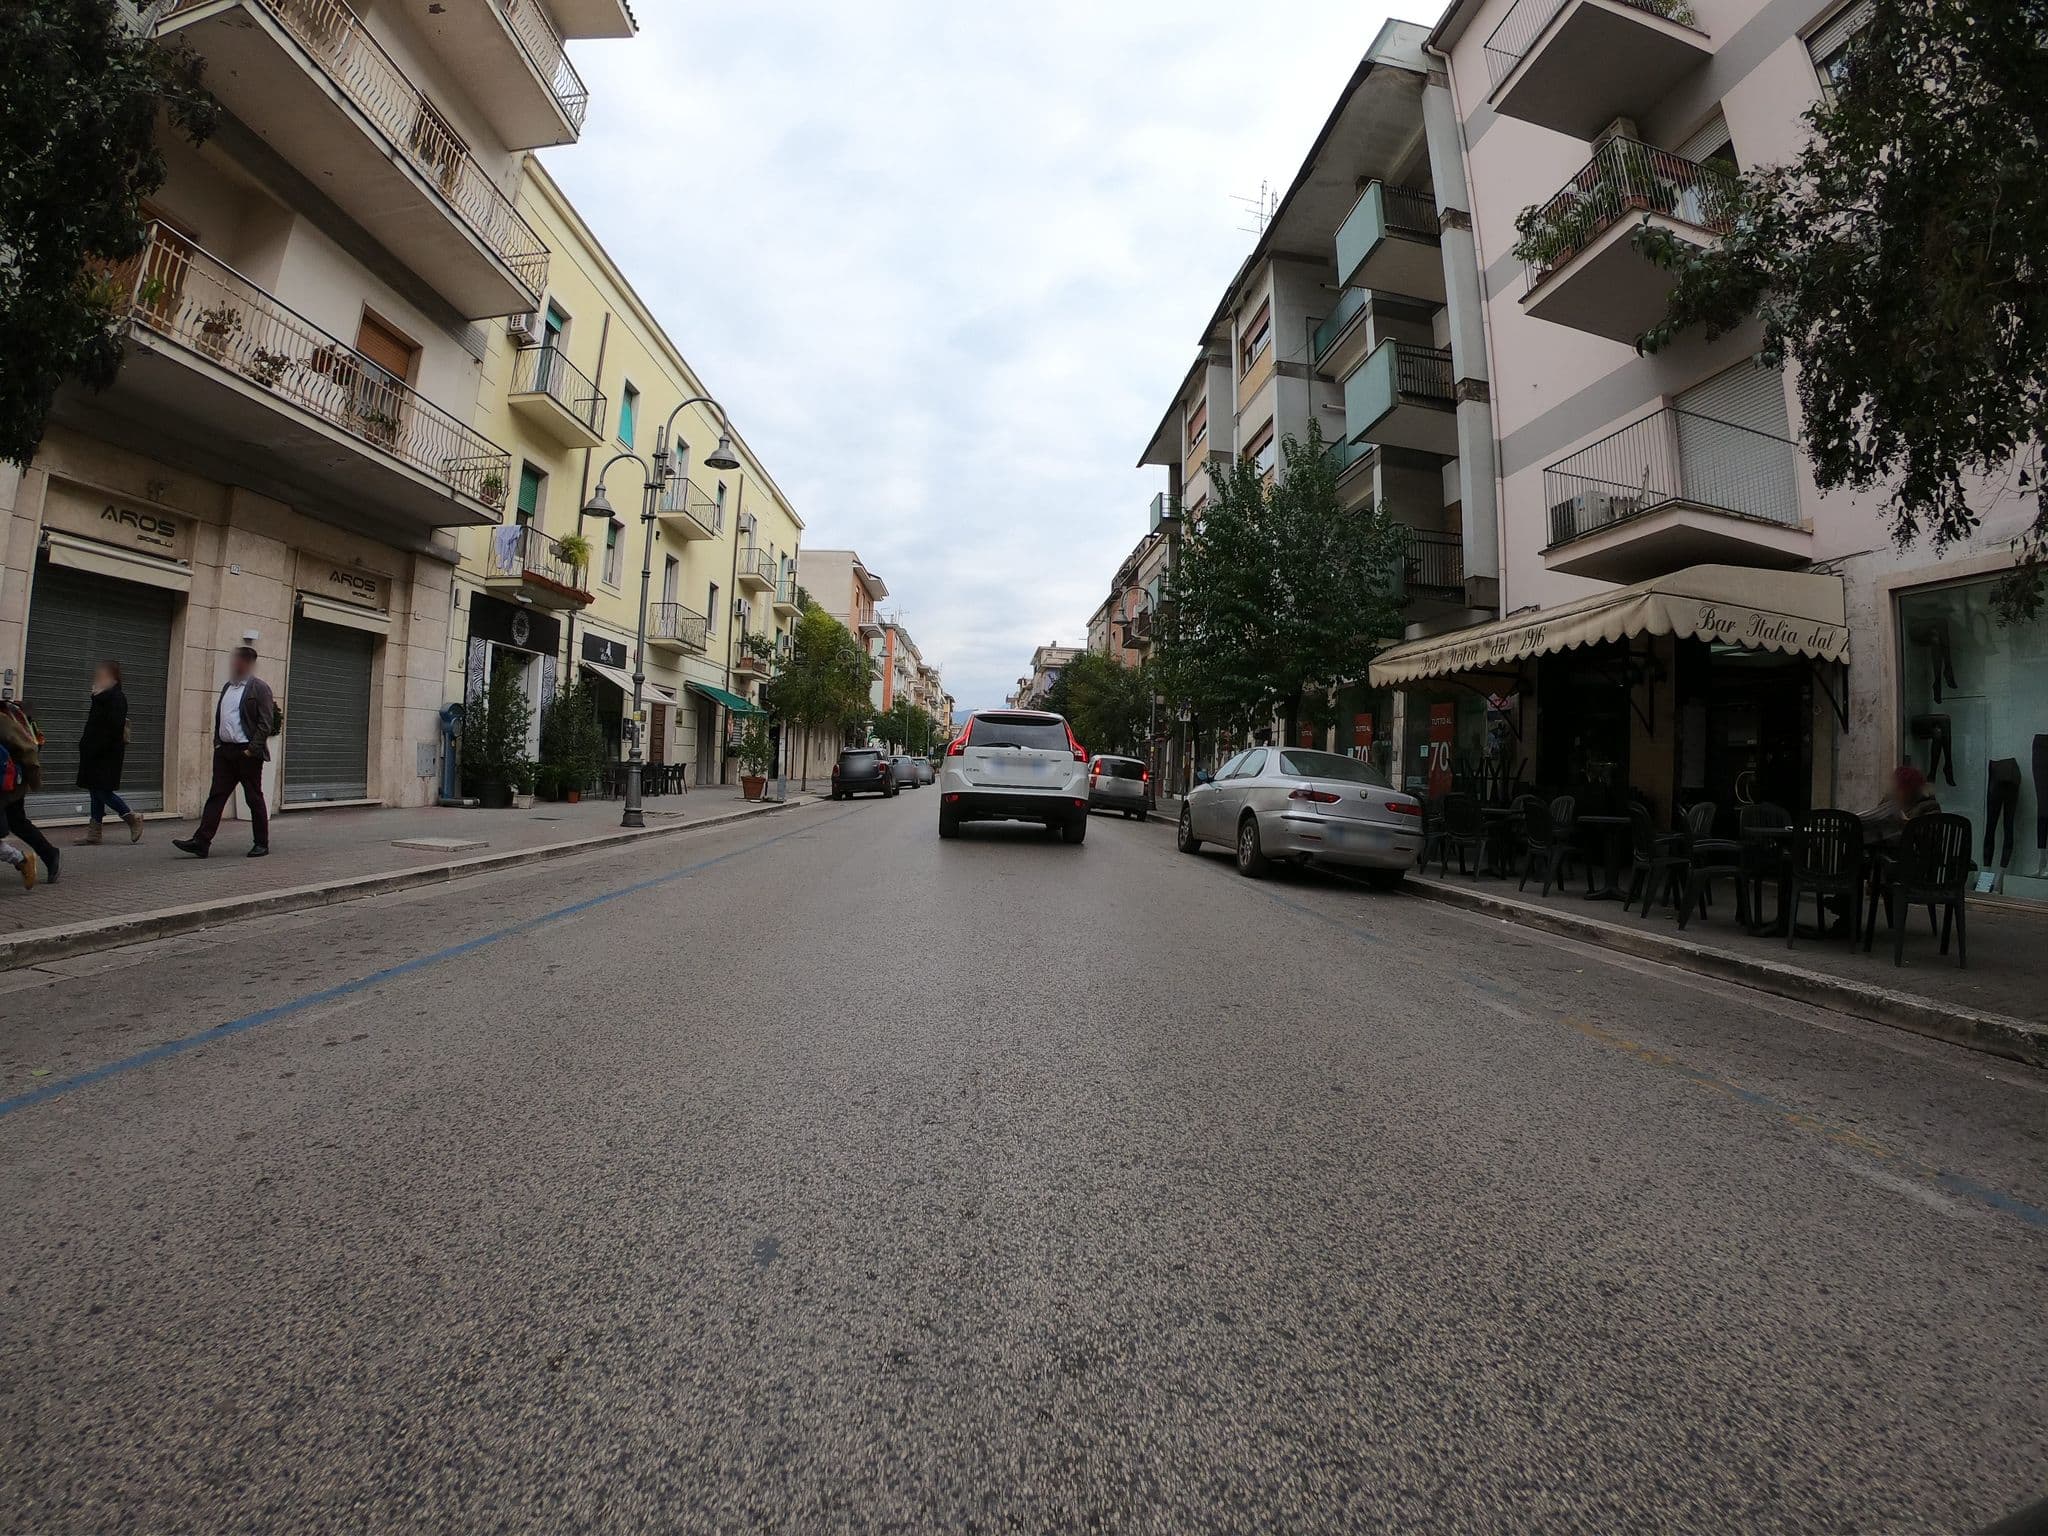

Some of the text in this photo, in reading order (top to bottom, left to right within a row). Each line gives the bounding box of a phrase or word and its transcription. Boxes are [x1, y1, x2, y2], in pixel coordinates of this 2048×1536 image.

[101, 504, 176, 538] AROS
[329, 570, 376, 592] AROS
[1696, 605, 1736, 634] Bar
[1746, 613, 1798, 644] Italia
[1807, 627, 1836, 650] dal
[1420, 626, 1546, 671] Bar Italia dal 1916
